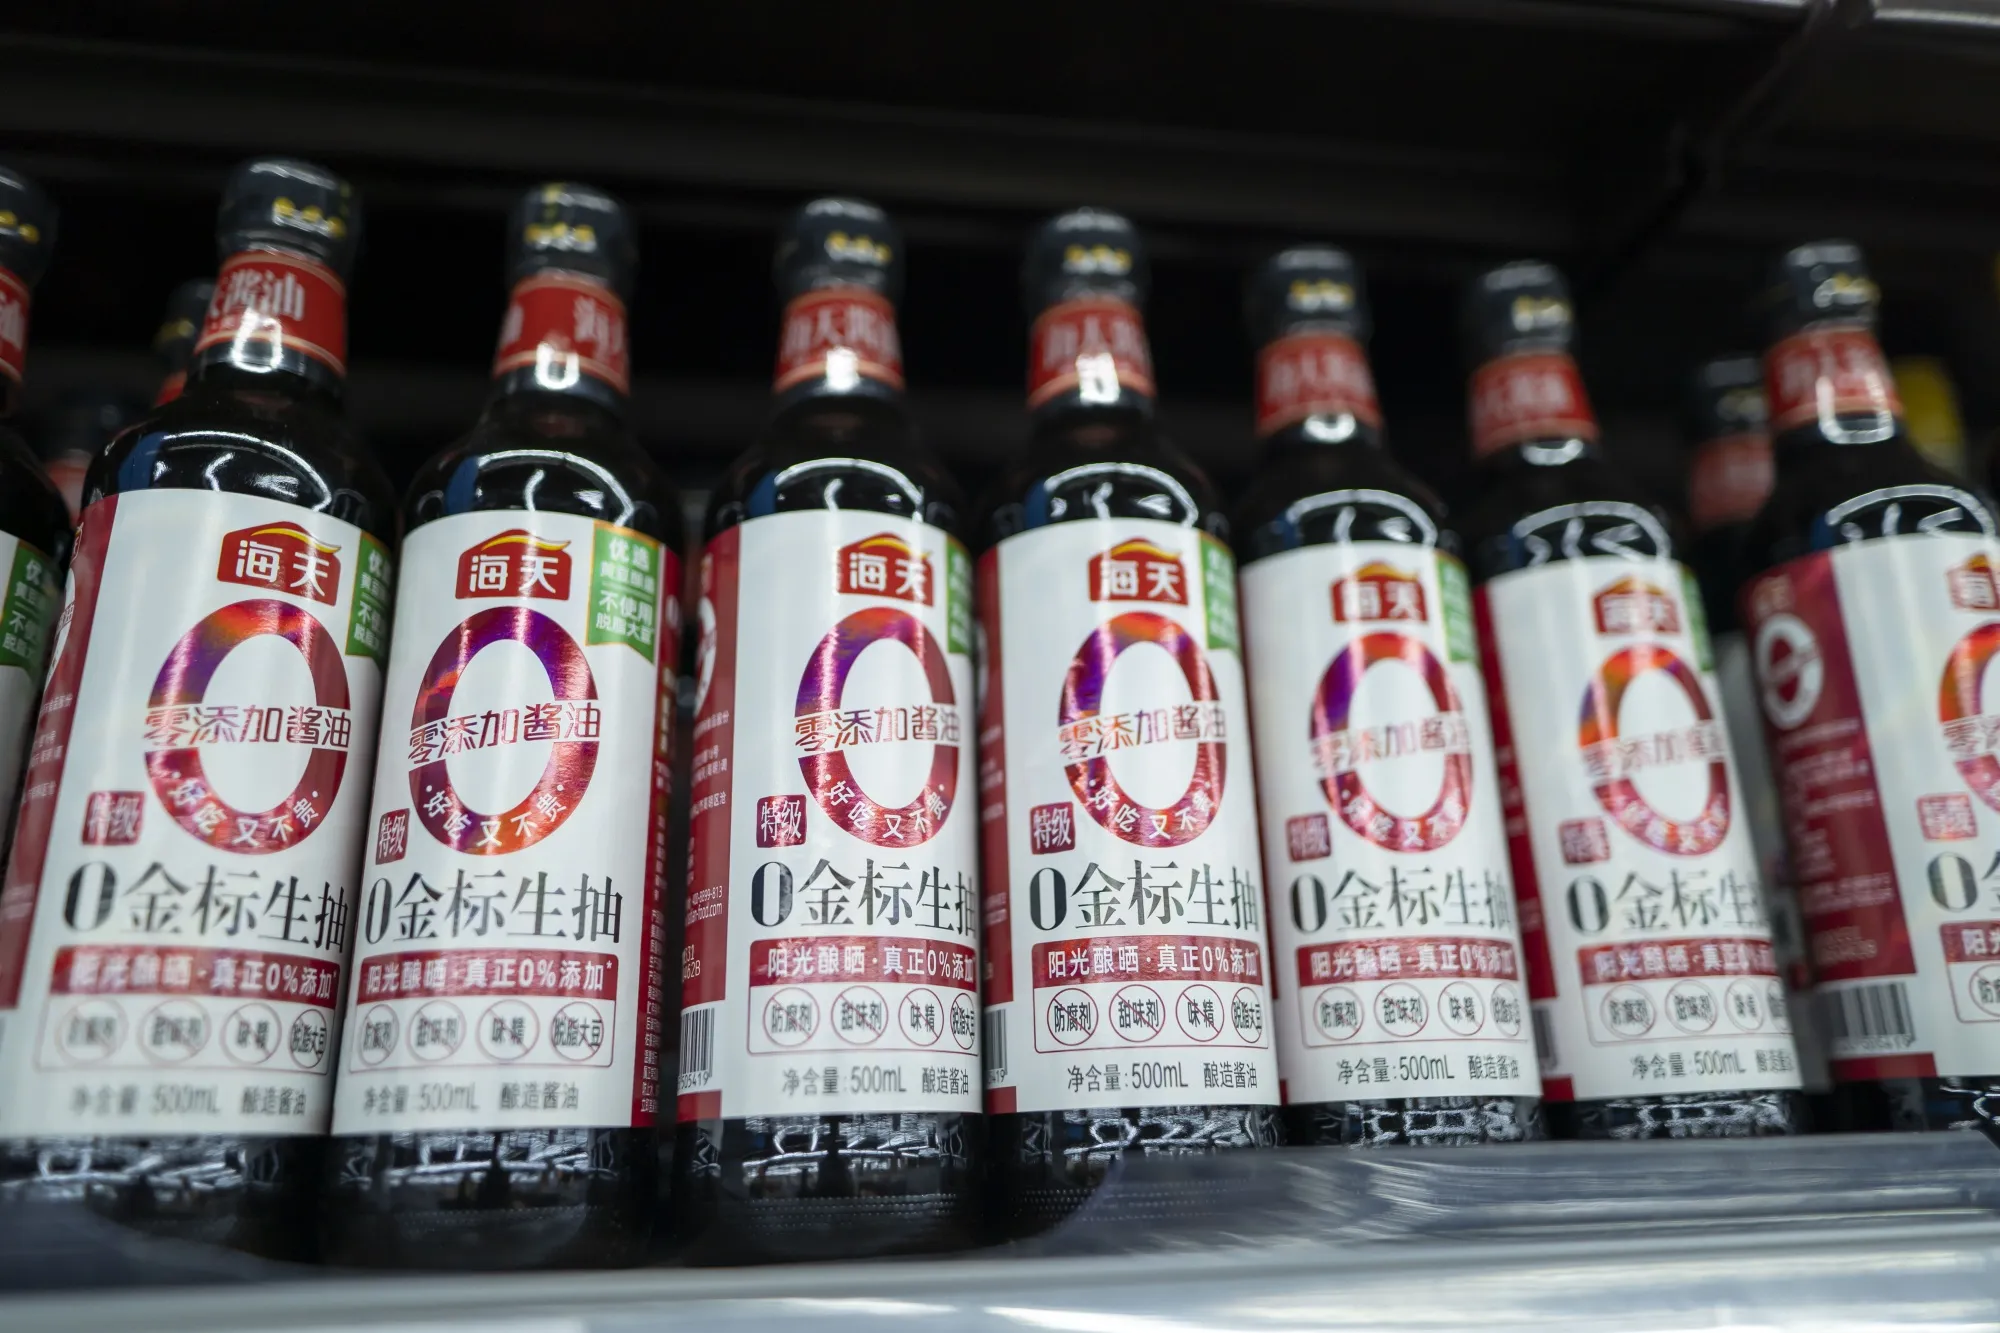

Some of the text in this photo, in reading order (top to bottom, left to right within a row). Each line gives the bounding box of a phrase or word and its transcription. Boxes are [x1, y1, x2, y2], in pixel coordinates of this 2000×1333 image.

[236, 540, 331, 597] 海天
[470, 555, 559, 594] 海天
[849, 553, 927, 600] 海天
[143, 704, 351, 747] 零添加酱油
[408, 702, 601, 764] 零添加酱油
[795, 705, 960, 751] 零添加酱油
[1059, 705, 1226, 759] 零添加酱油
[424, 790, 566, 847] 好吃又不贵
[760, 799, 802, 842] 特级
[823, 781, 947, 839] 好吃又不贵
[1032, 806, 1071, 850] 特级
[379, 815, 406, 857] 特级
[62, 861, 348, 953] 0金标生抽
[364, 868, 622, 944] 0金标生抽
[751, 858, 977, 938] 0金标生抽
[1030, 859, 1259, 933] 0金标生抽
[553, 1017, 601, 1048] 脱脂大豆
[771, 1002, 813, 1034] 防腐剂
[841, 999, 882, 1033] 甜味剂
[910, 1002, 936, 1033] 味精
[1054, 1001, 1092, 1032] 防腐剂
[1118, 998, 1160, 1030] 甜味剂
[1187, 998, 1215, 1028] 味精
[1233, 1001, 1262, 1031] 脱脂大豆
[499, 1081, 579, 1112] 酿造酱油
[921, 1066, 969, 1096] 酿造酱油
[1067, 1061, 1258, 1093] 净含量:500mL 酿造酱油
